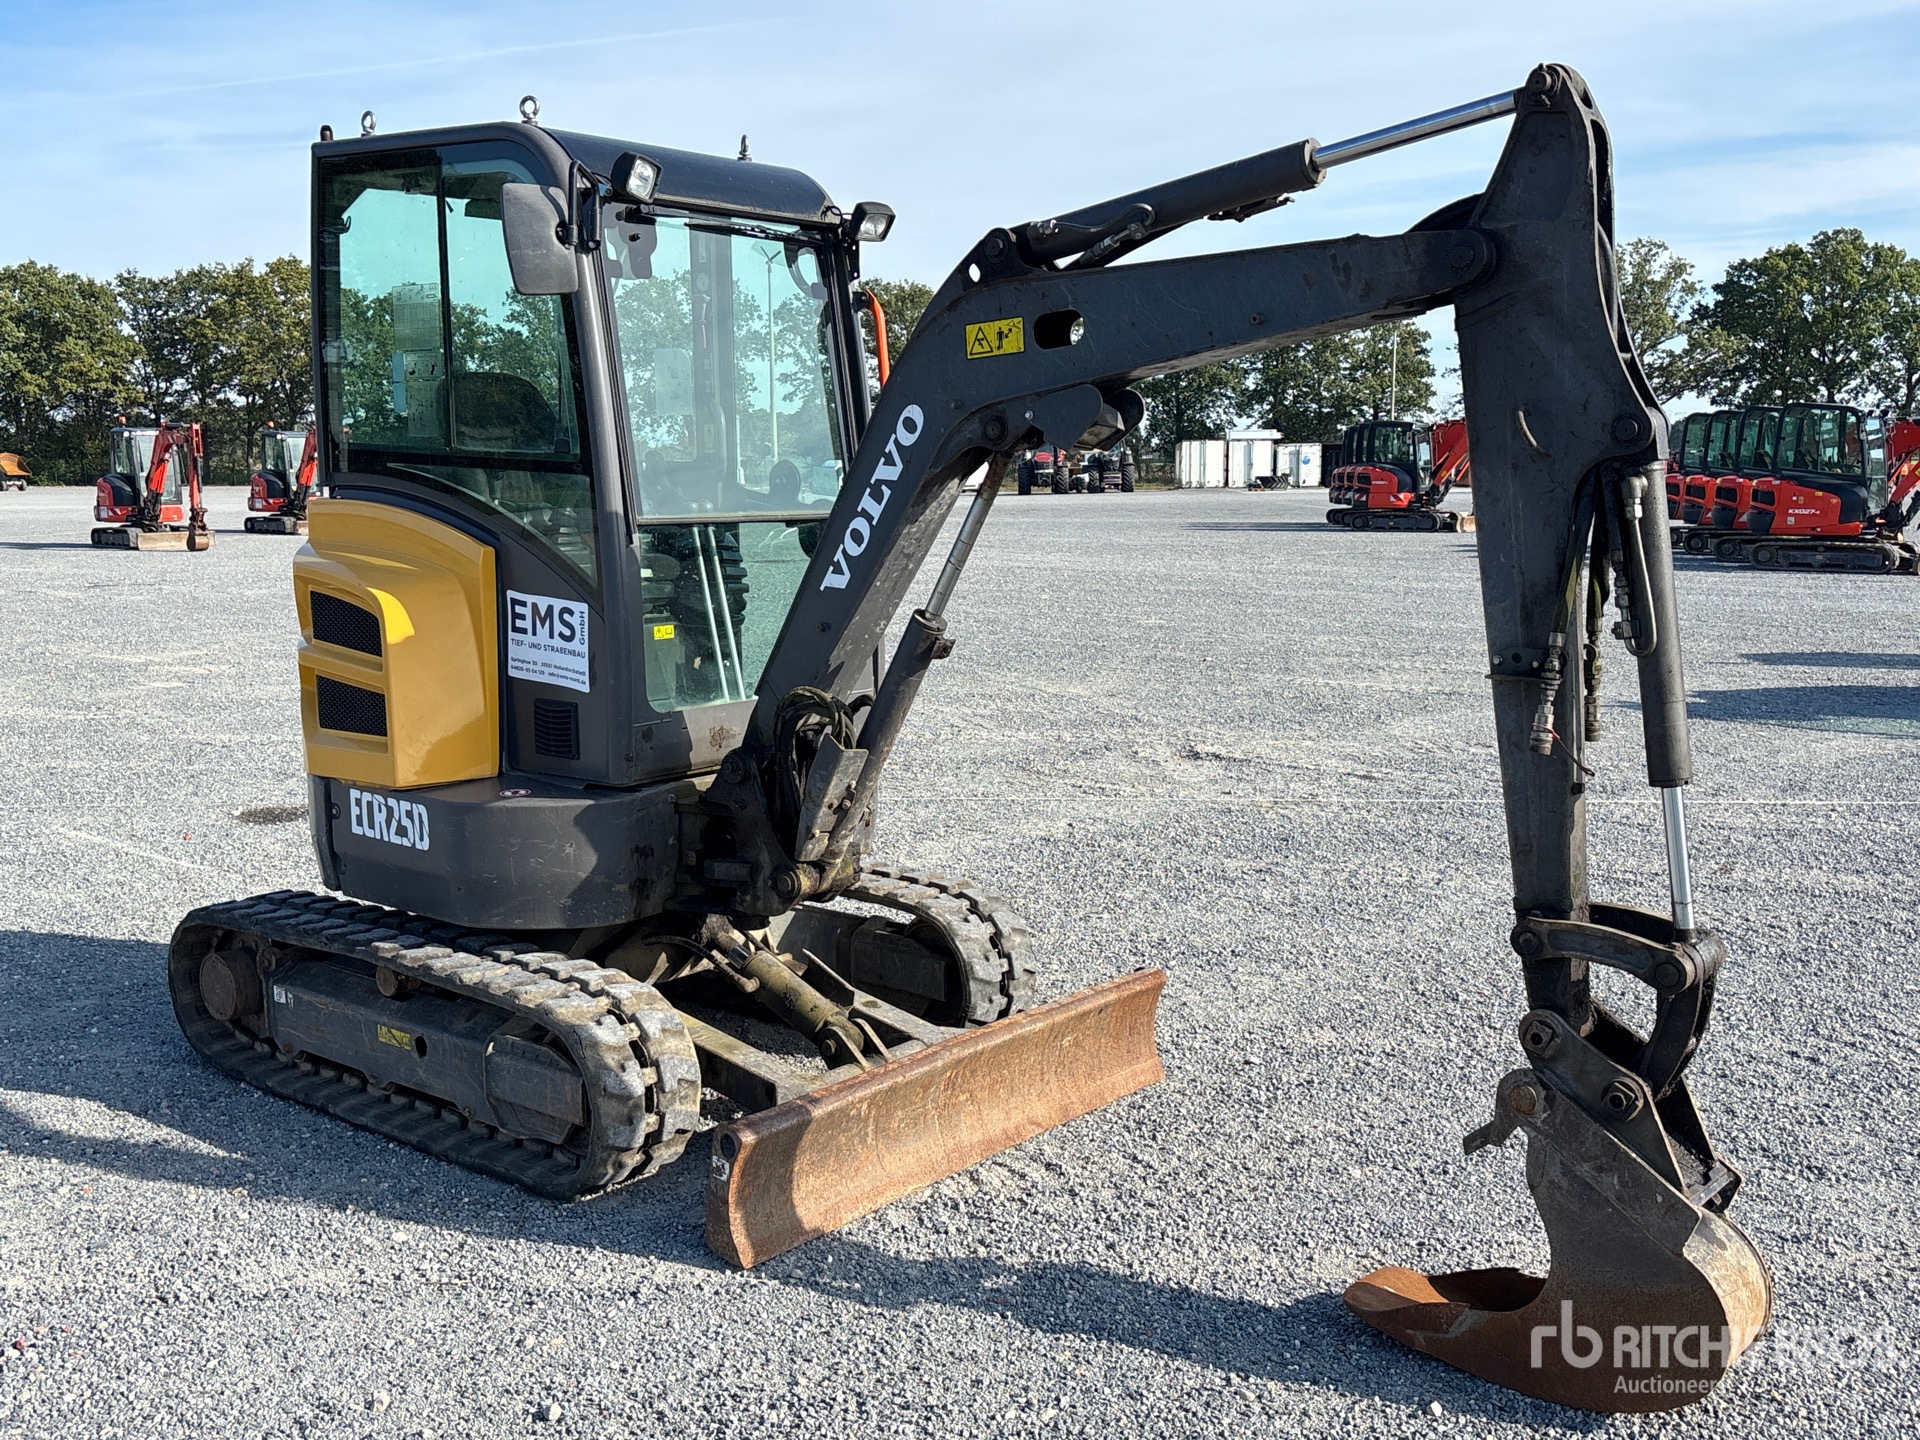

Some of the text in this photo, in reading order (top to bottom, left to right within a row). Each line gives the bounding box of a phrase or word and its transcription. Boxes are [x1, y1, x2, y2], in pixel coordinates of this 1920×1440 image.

[820, 404, 924, 591] VOLVO
[510, 597, 576, 643] EMS
[511, 638, 527, 648] TIEF-
[528, 641, 542, 651] UND
[350, 788, 430, 851] ECR25D
